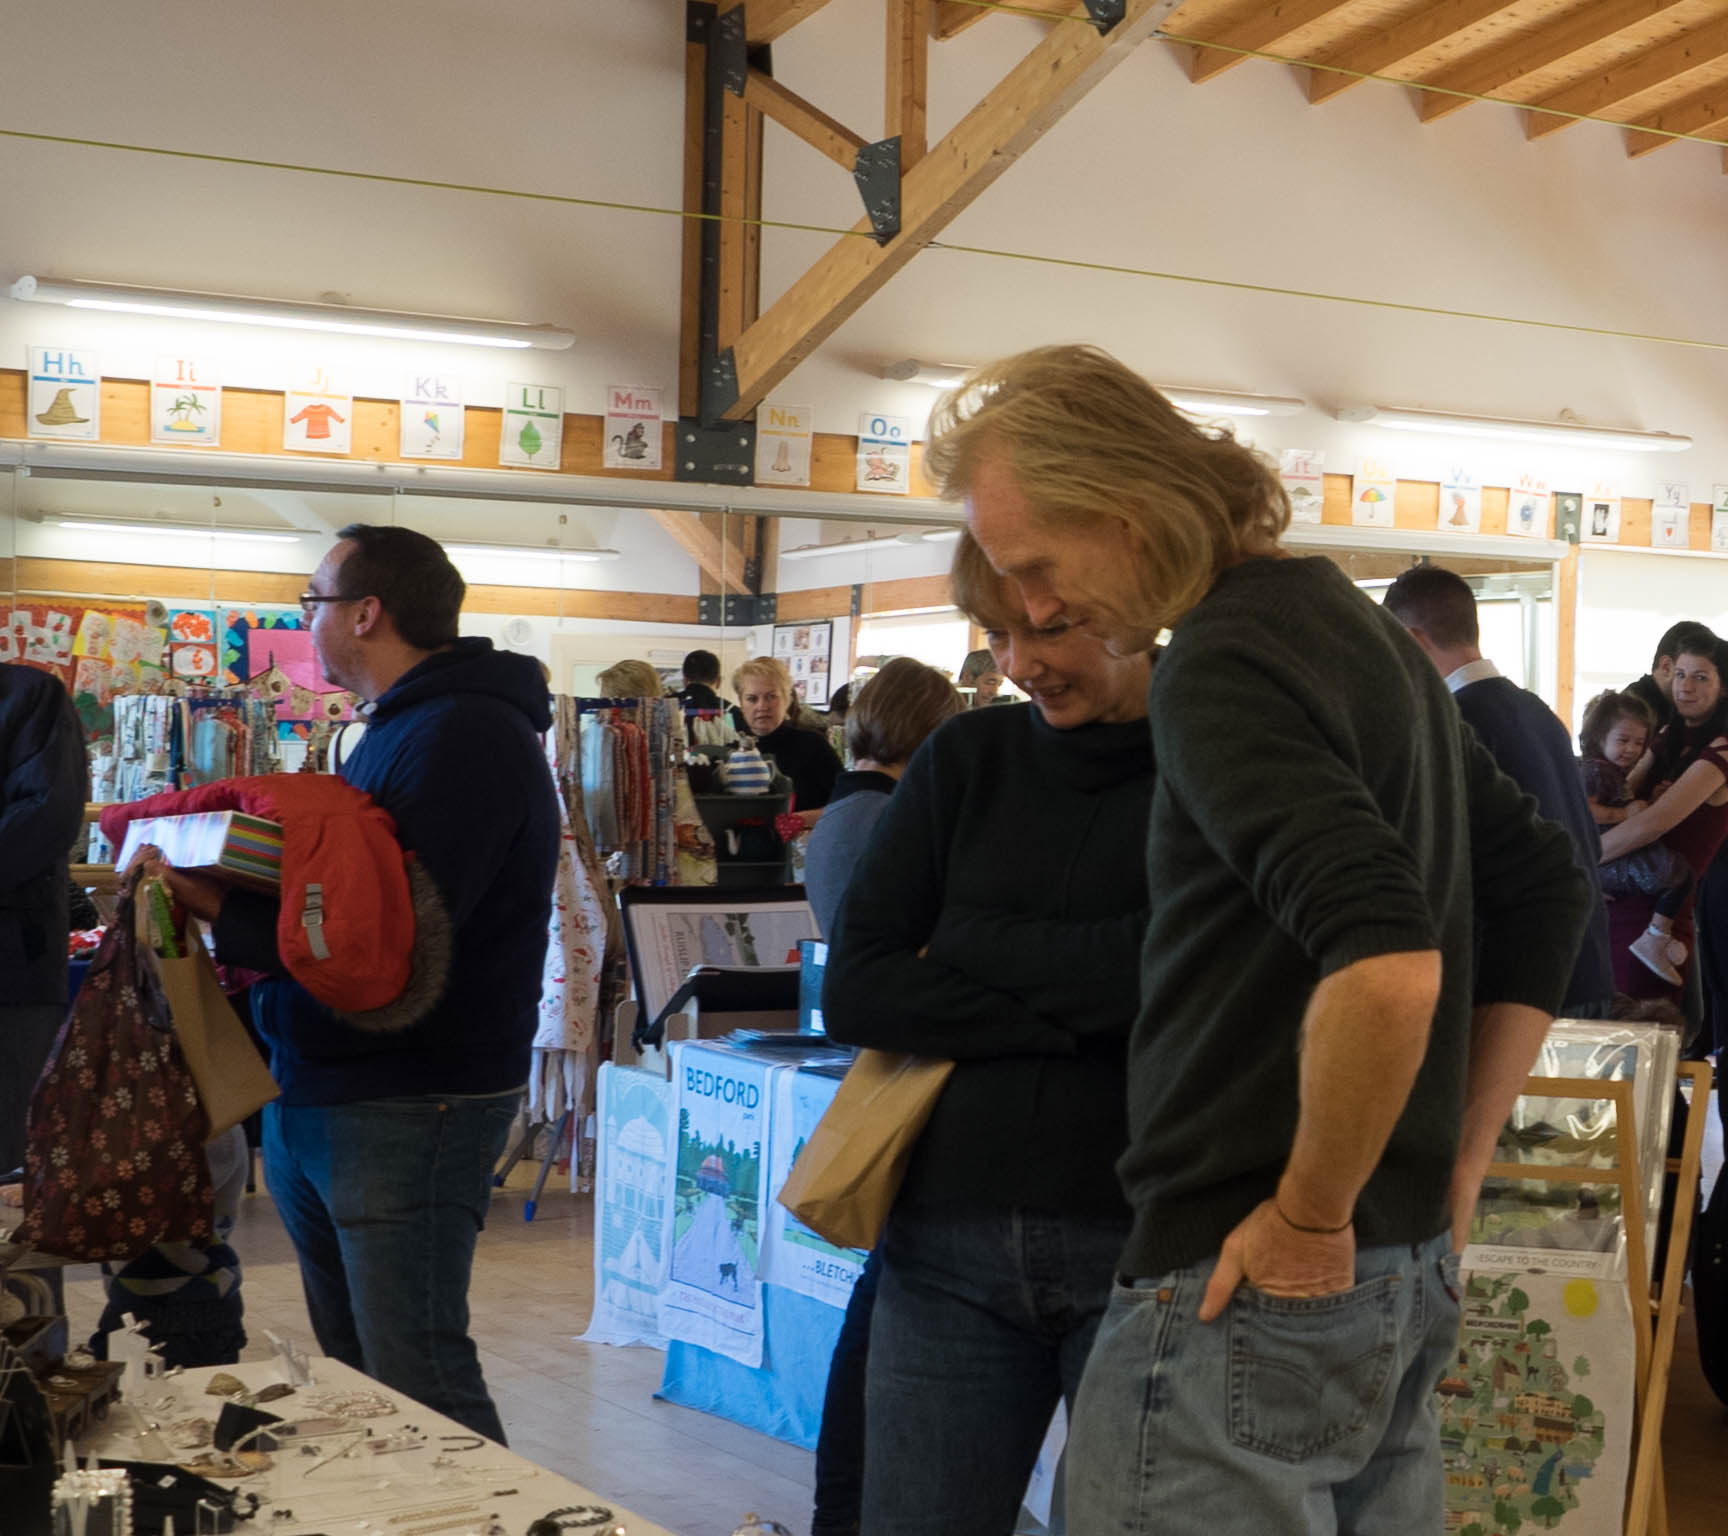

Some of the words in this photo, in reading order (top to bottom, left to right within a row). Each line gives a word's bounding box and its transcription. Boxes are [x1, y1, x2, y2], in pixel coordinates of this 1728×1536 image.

[43, 351, 84, 375] Hh
[176, 359, 197, 382] Ii
[415, 376, 449, 399] Kk
[522, 387, 546, 410] Ll
[613, 391, 654, 411] Mm
[769, 407, 800, 427] Nn
[871, 418, 901, 439] Oo
[1665, 485, 1681, 504] Yy
[686, 1067, 760, 1109] BEDFORD
[1517, 1255, 1528, 1265] TO
[1532, 1256, 1549, 1266] THE
